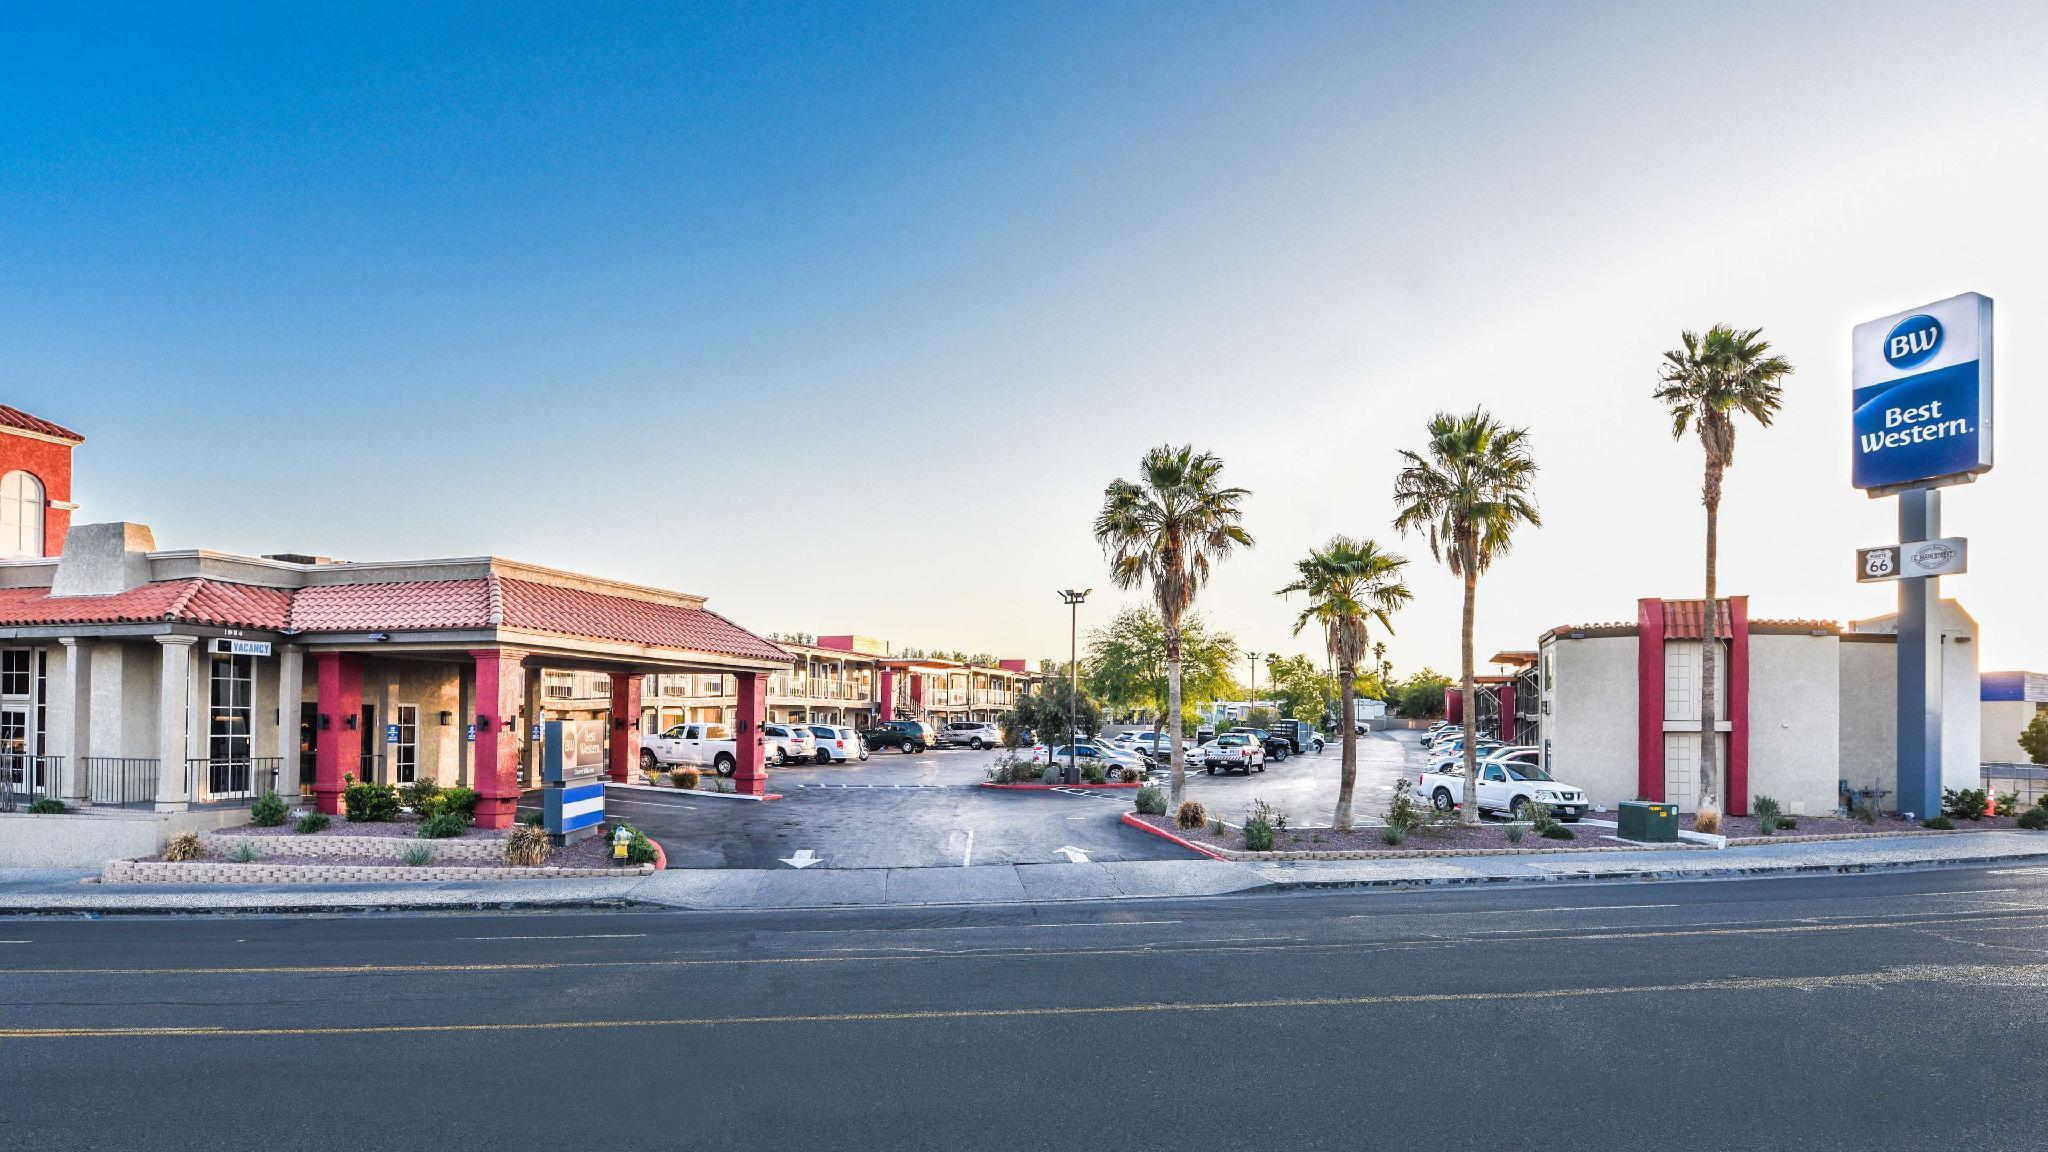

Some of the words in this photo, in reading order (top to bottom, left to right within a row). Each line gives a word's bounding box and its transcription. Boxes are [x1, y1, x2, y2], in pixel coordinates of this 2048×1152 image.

[1890, 326, 1938, 359] BW
[1885, 400, 1943, 428] Best
[1870, 559, 1888, 572] 66
[234, 642, 269, 654] VACANCY
[584, 730, 596, 742] Best
[564, 740, 574, 752] BW
